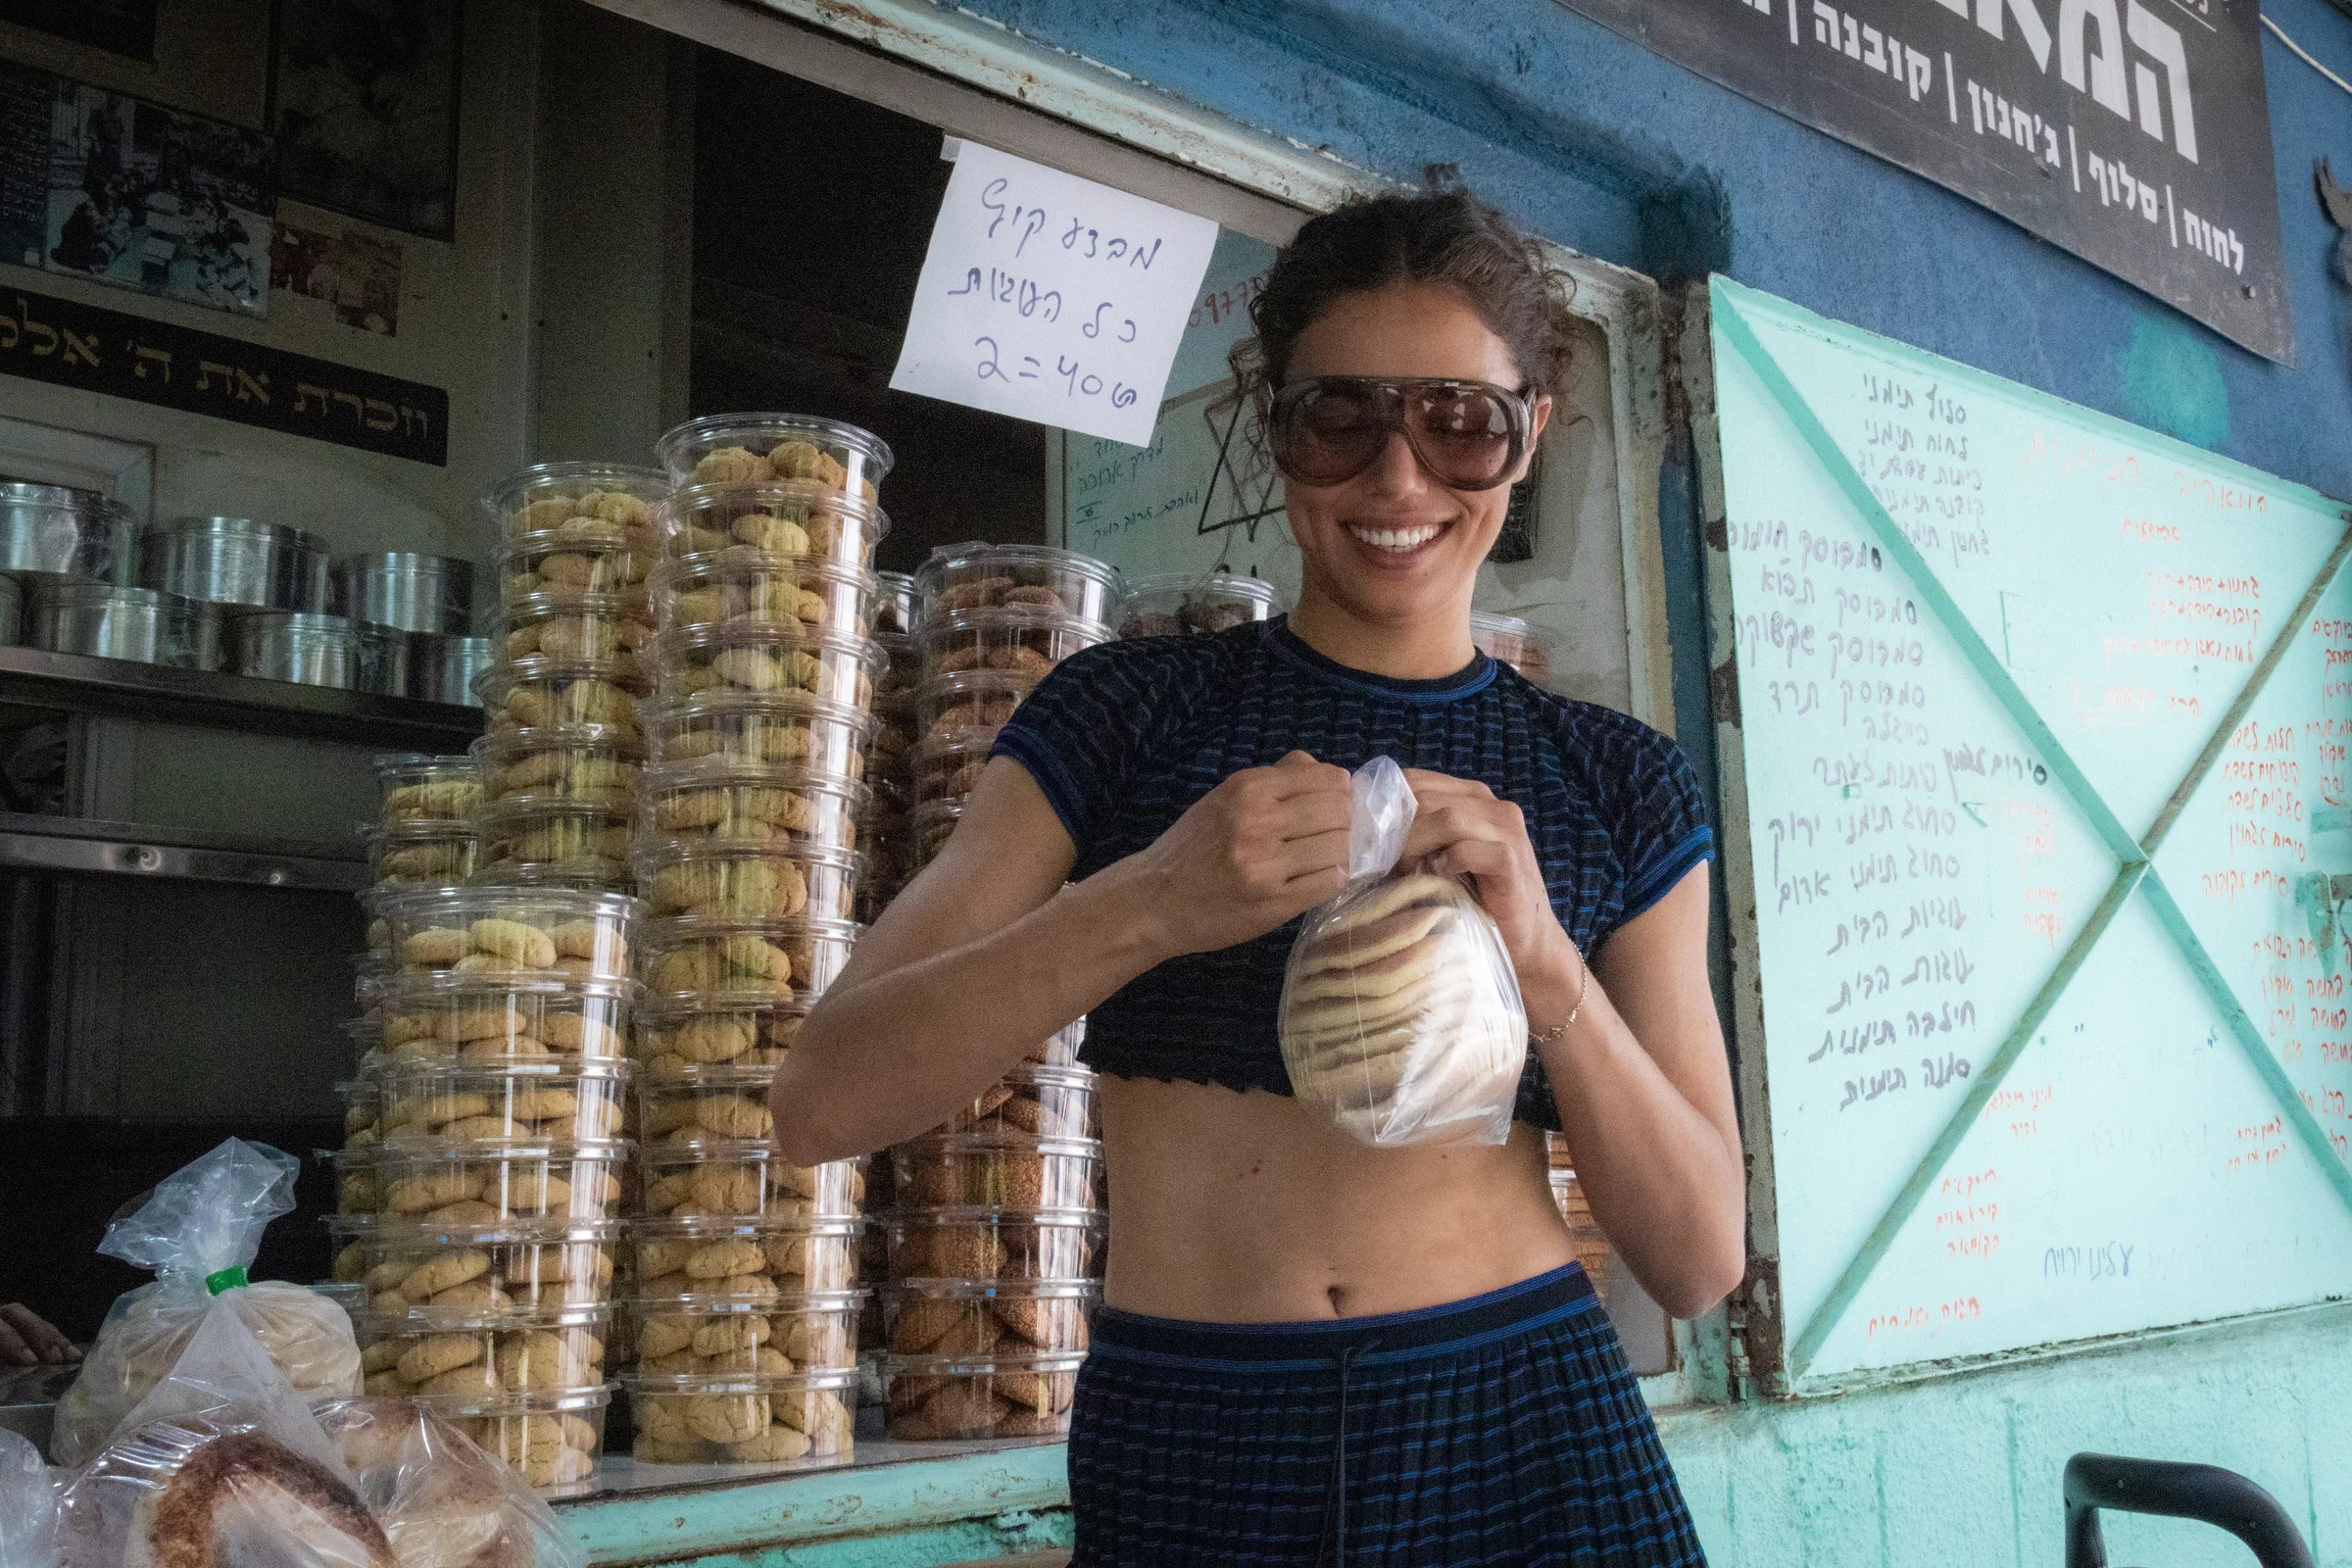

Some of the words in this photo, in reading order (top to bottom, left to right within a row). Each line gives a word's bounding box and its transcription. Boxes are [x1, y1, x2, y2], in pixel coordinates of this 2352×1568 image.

[1813, 0, 1931, 101] קובנה
[1967, 77, 2061, 168] ג'חנון
[2088, 149, 2157, 224] סלוף
[1061, 217, 1162, 270] מבצע
[2183, 207, 2245, 275] לחוח
[947, 267, 1062, 323] העוגיות
[1082, 301, 1137, 344] כל
[127, 339, 172, 382] ה'
[199, 359, 270, 405] את
[295, 378, 428, 440] וזכרת
[1863, 373, 1914, 410] תימני
[1864, 418, 1914, 452] תימני
[1835, 587, 1918, 627] סמבוסק
[1828, 631, 1923, 680] סמבוסק
[1768, 680, 1819, 716] תרד
[1839, 678, 1926, 727] סמבוסק
[1836, 804, 1895, 845] תימני
[1901, 798, 1958, 836] סחוג
[1767, 809, 1821, 889] ירוק
[1848, 852, 1899, 891] תימני
[1906, 843, 1961, 881] סחוג
[1777, 868, 1832, 916] אדום
[1825, 908, 1889, 957] הבית
[1900, 896, 1968, 939] עוגיות
[1825, 963, 1891, 1016] הבית
[1900, 946, 1976, 987] עוגות
[1807, 1019, 1897, 1065] תימנית
[1905, 999, 1977, 1039] חילבה
